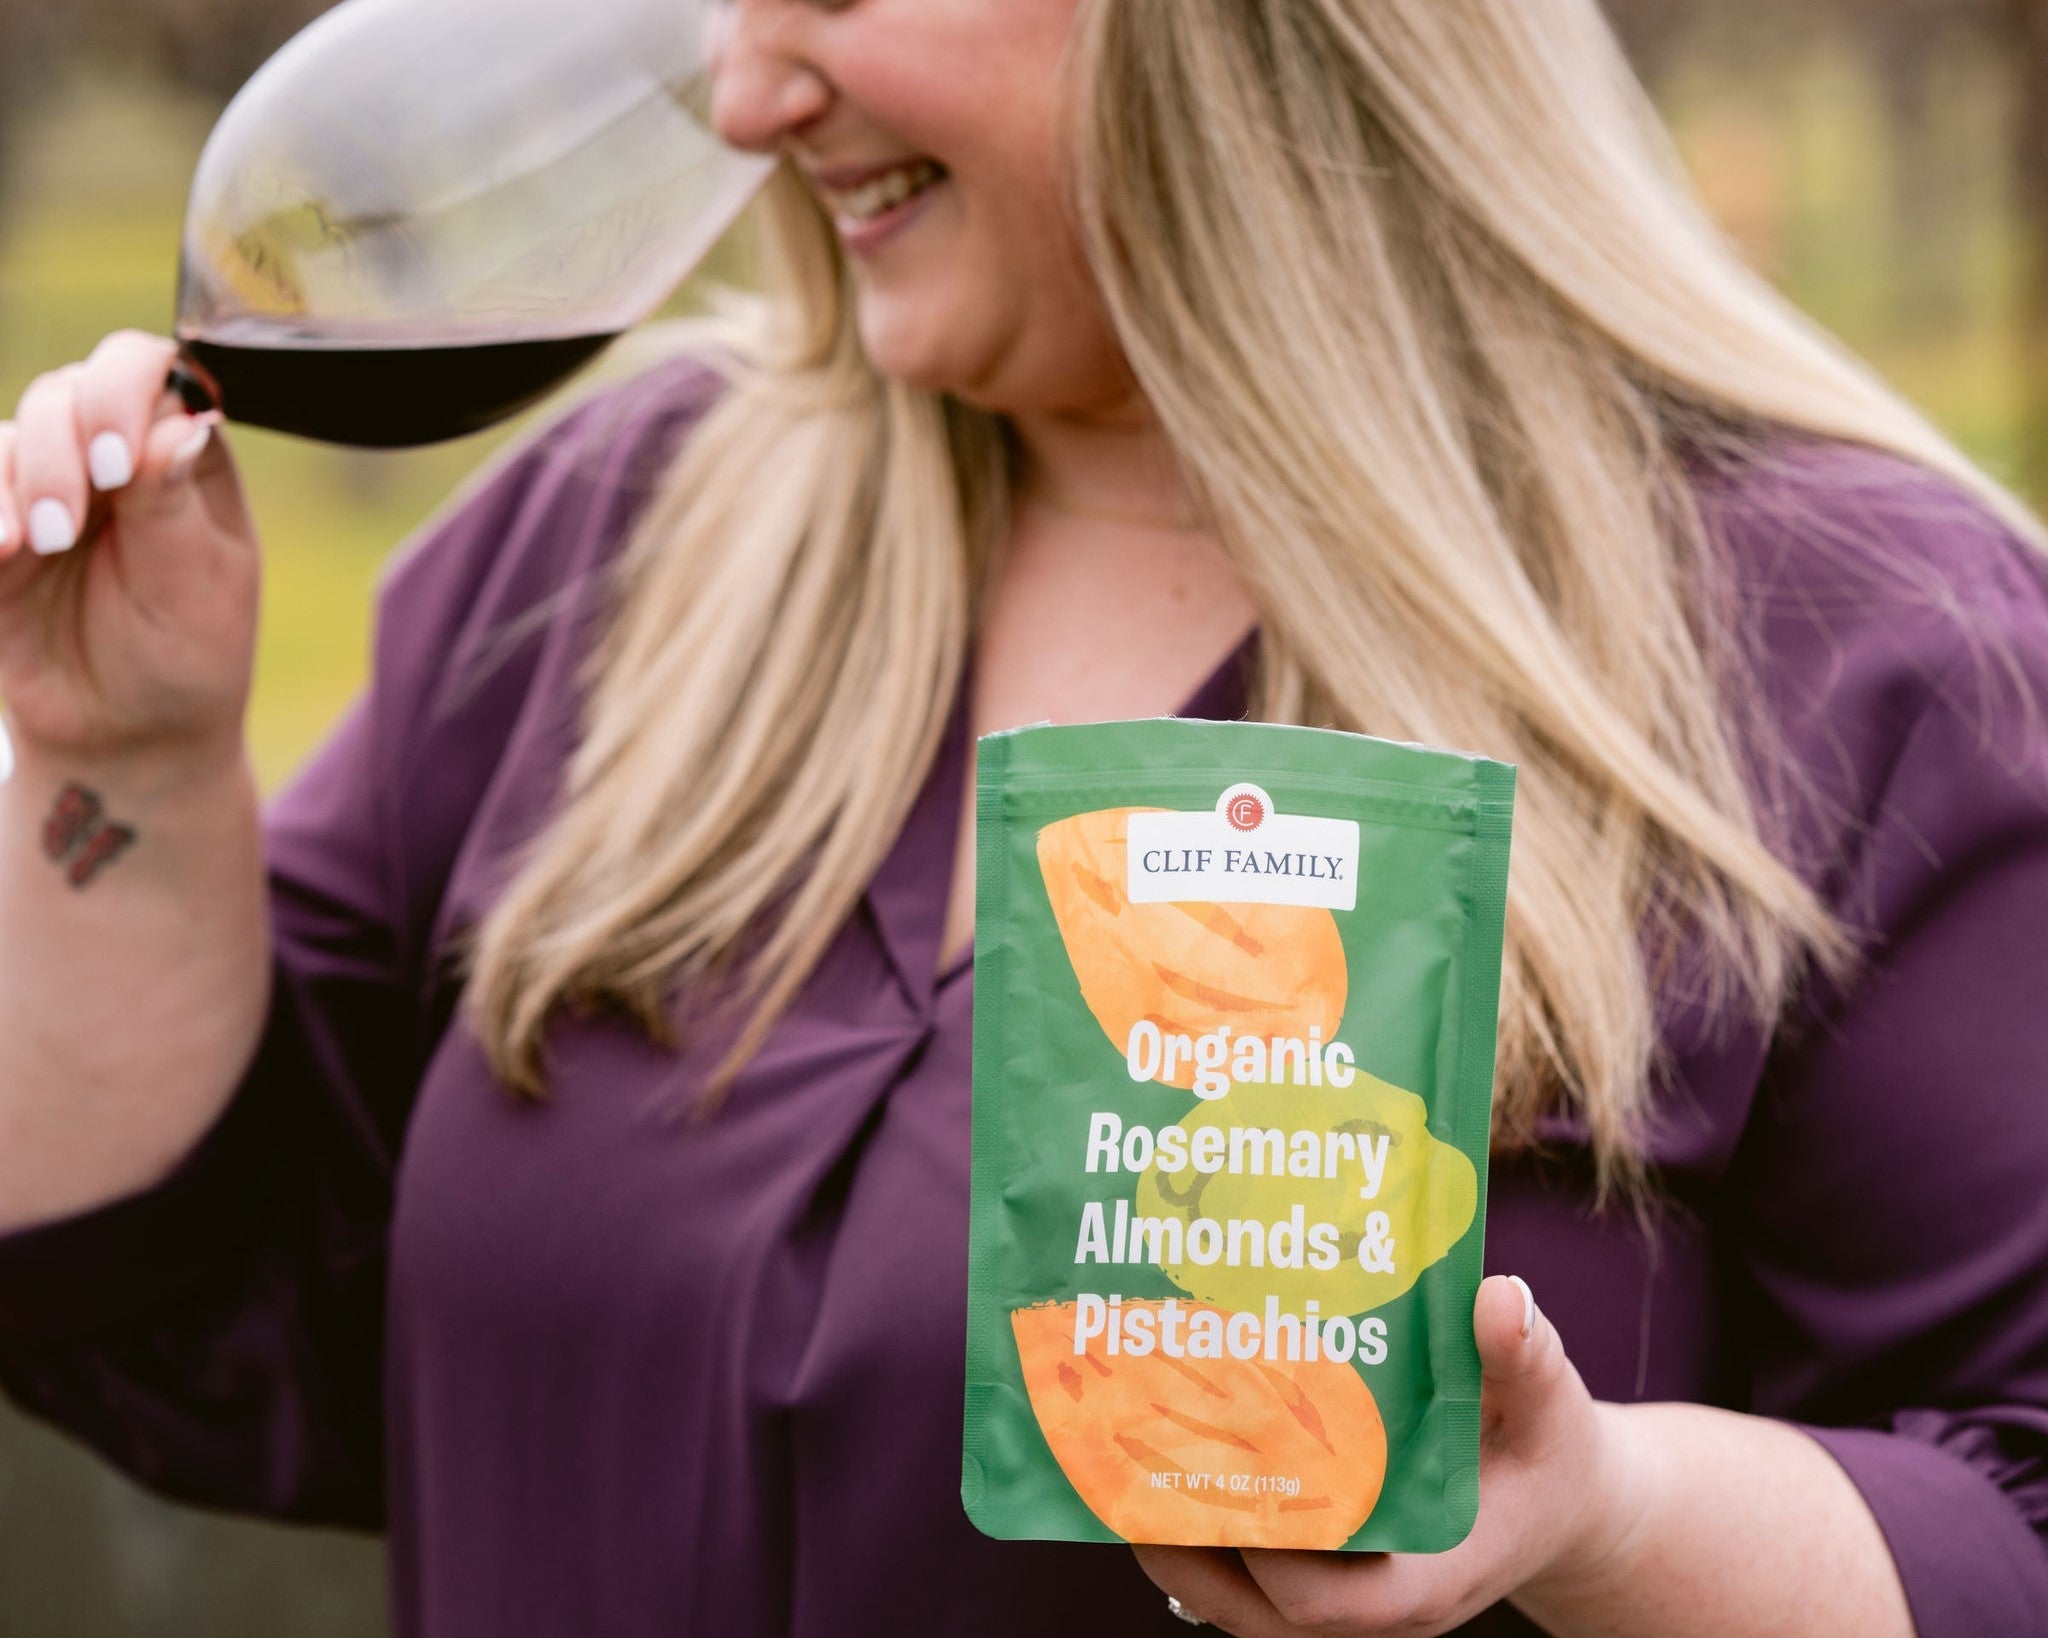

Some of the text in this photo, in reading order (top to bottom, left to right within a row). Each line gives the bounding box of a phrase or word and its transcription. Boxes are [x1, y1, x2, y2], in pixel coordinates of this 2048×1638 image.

[1143, 849, 1212, 873] CLIF
[1126, 1020, 1355, 1100] Organic
[1085, 1112, 1389, 1199] Rosemary
[1074, 1199, 1396, 1275] Almonds &
[1074, 1293, 1388, 1365] Pistachios
[1151, 1472, 1301, 1496] NET WT 4 OZ (113g)
